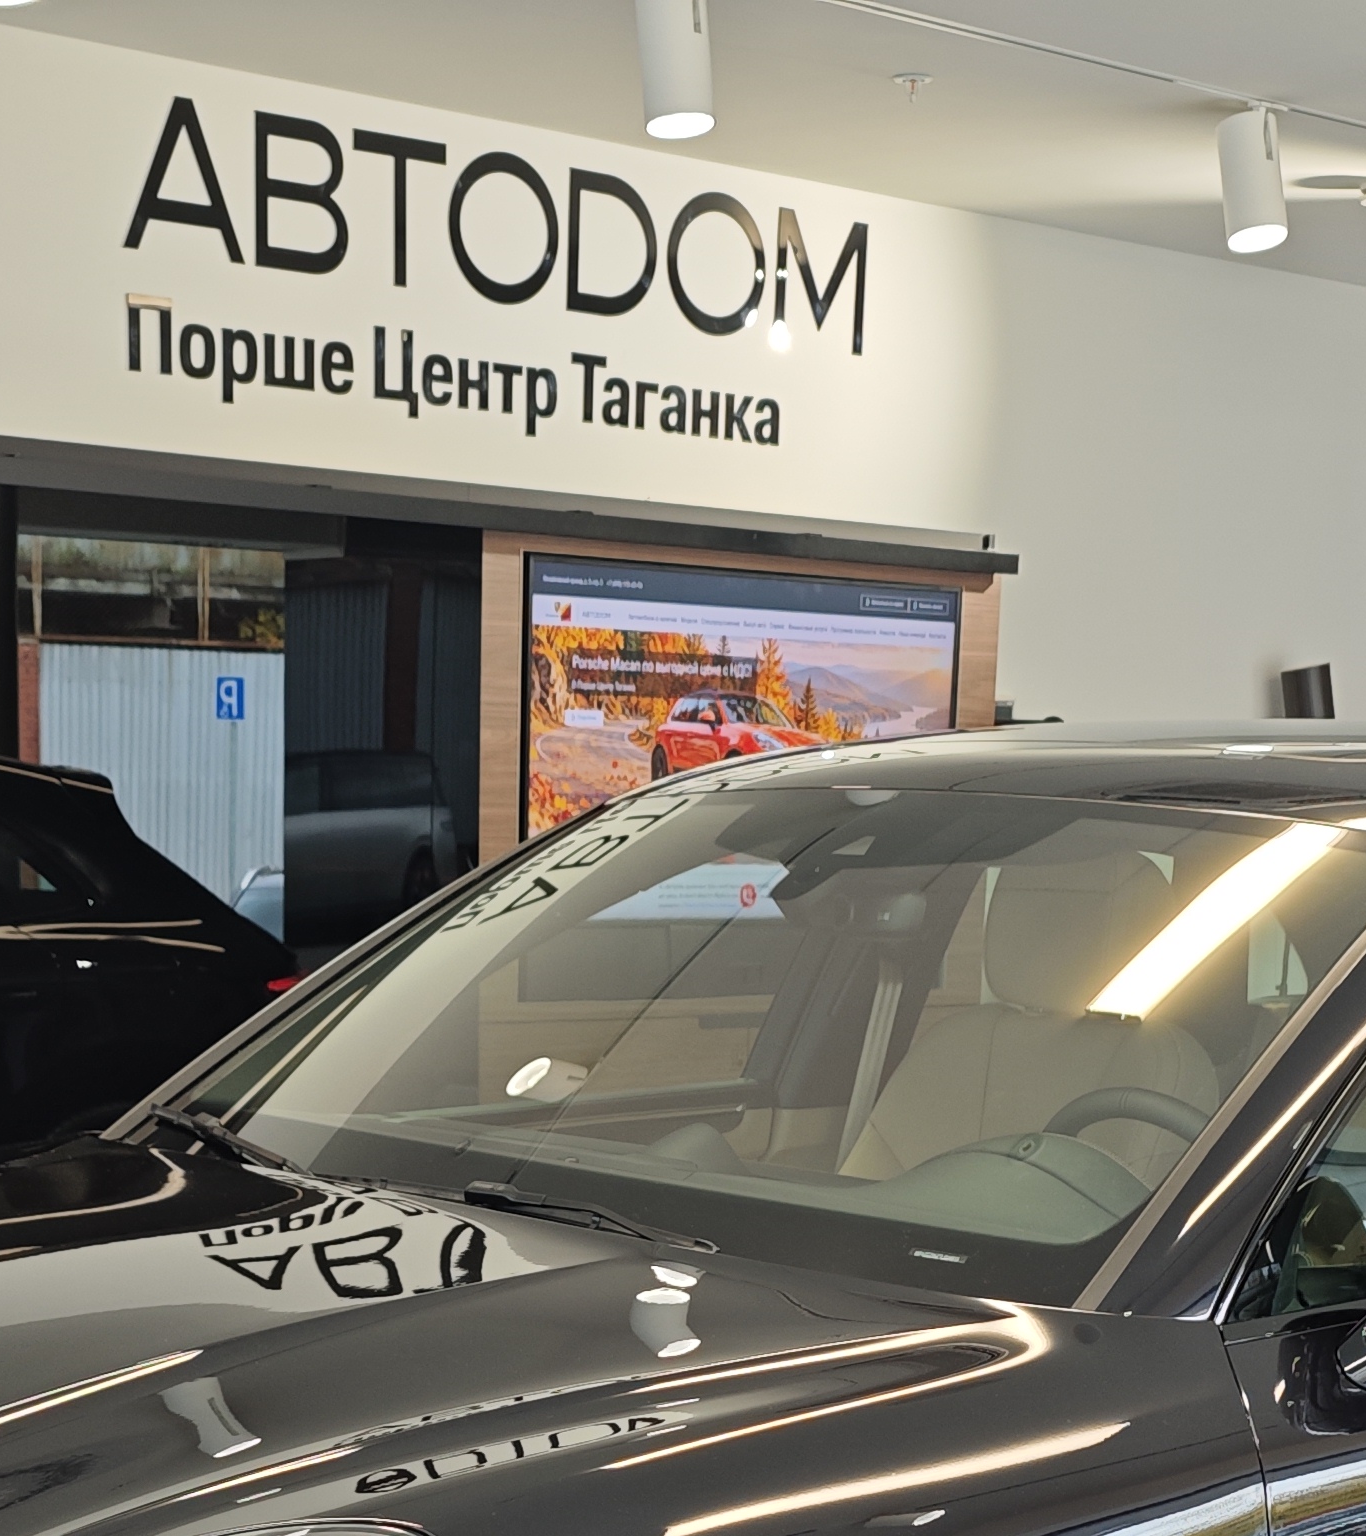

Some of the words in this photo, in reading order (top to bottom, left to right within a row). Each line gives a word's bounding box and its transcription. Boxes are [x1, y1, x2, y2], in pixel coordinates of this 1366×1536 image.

[124, 292, 354, 403] Порше
[373, 325, 559, 437] Центр
[571, 352, 781, 447] Таганка
